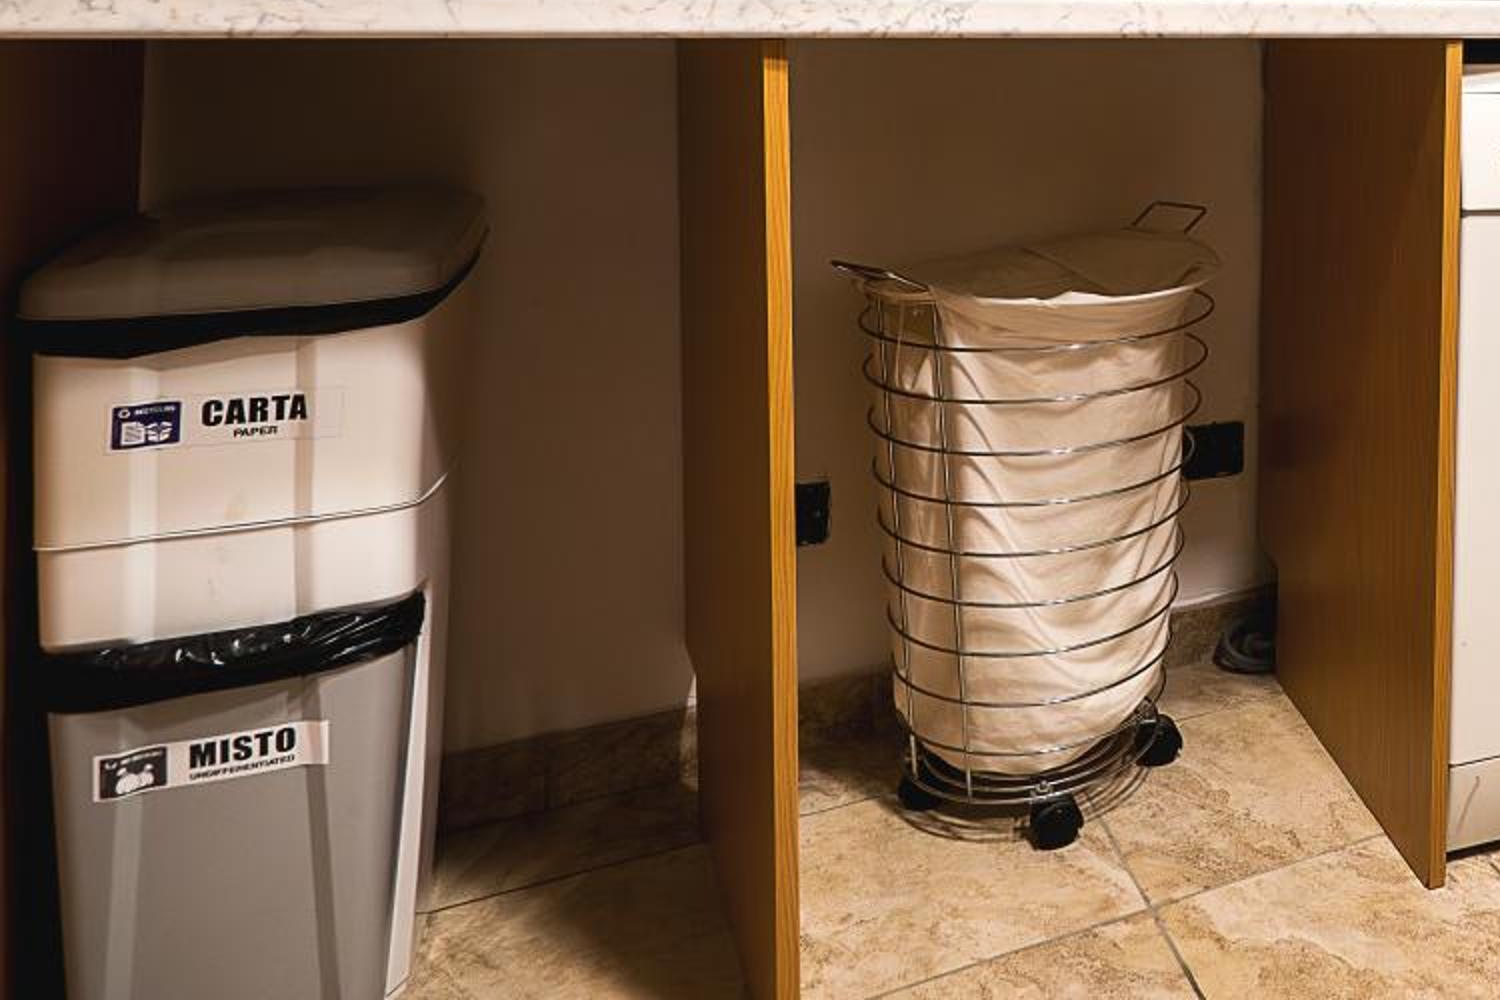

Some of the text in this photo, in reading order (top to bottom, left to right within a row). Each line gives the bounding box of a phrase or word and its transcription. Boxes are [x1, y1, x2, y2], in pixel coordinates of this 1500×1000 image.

[202, 394, 307, 427] CARTA
[233, 424, 278, 438] PAPER
[189, 726, 296, 769] MISTO
